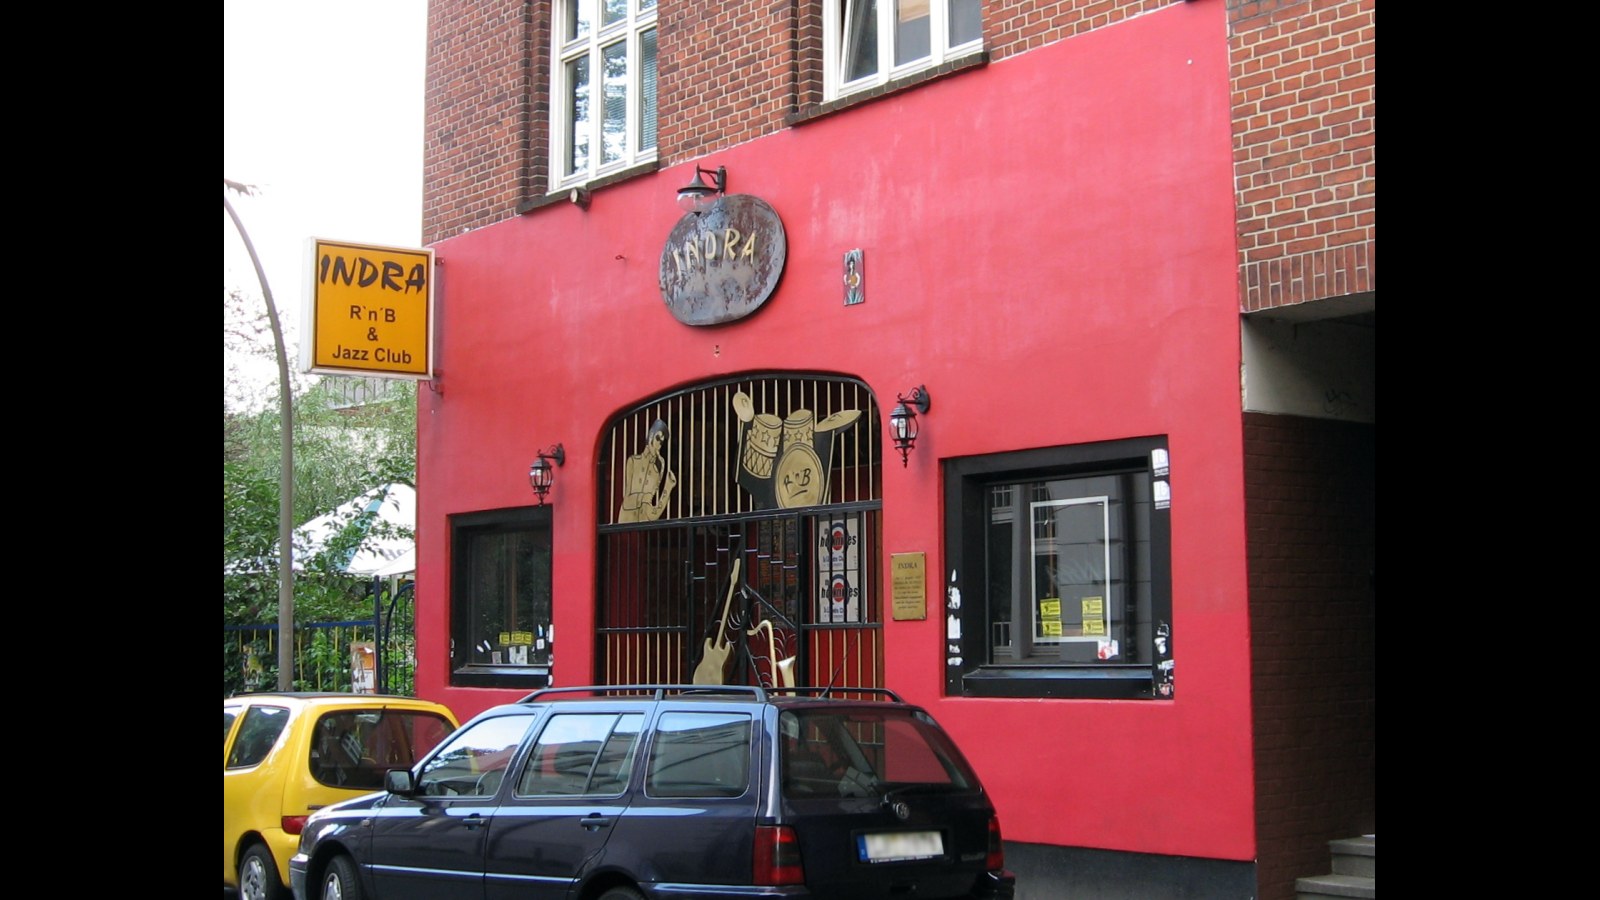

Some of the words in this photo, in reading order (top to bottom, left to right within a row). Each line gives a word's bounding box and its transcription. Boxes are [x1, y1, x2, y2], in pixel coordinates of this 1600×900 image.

[671, 228, 757, 281] INDRA
[320, 254, 425, 295] INDRA
[367, 326, 379, 342] &
[332, 344, 369, 361] Jazz
[374, 347, 412, 364] Club
